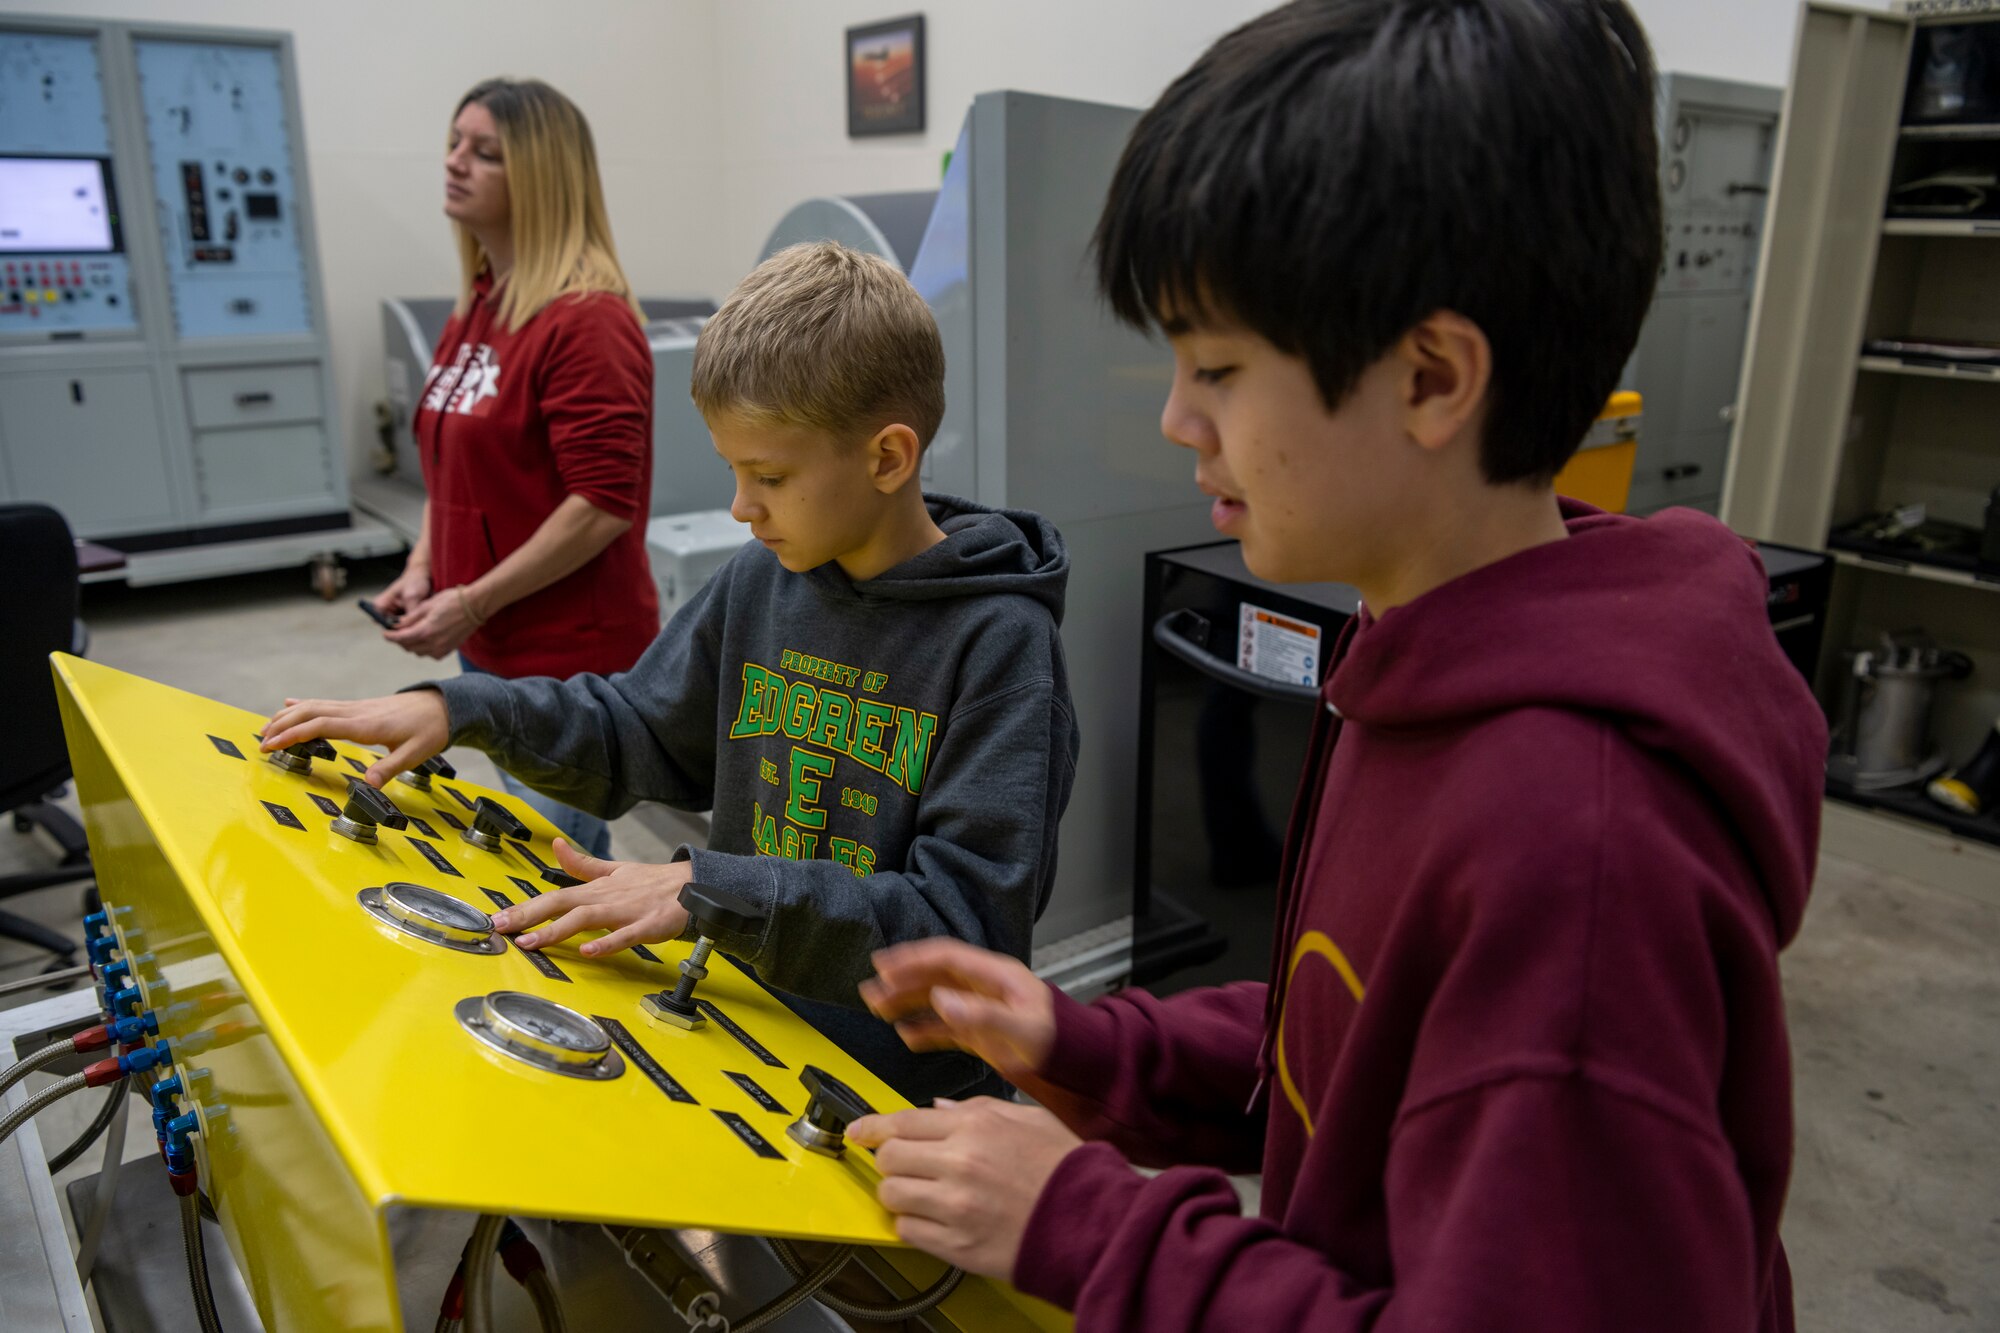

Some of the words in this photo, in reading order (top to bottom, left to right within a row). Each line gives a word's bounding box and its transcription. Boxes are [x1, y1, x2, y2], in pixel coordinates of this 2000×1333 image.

[781, 650, 859, 687] PROPERTY
[863, 671, 887, 693] OF
[730, 664, 937, 795] EDGREN
[785, 746, 836, 830] E
